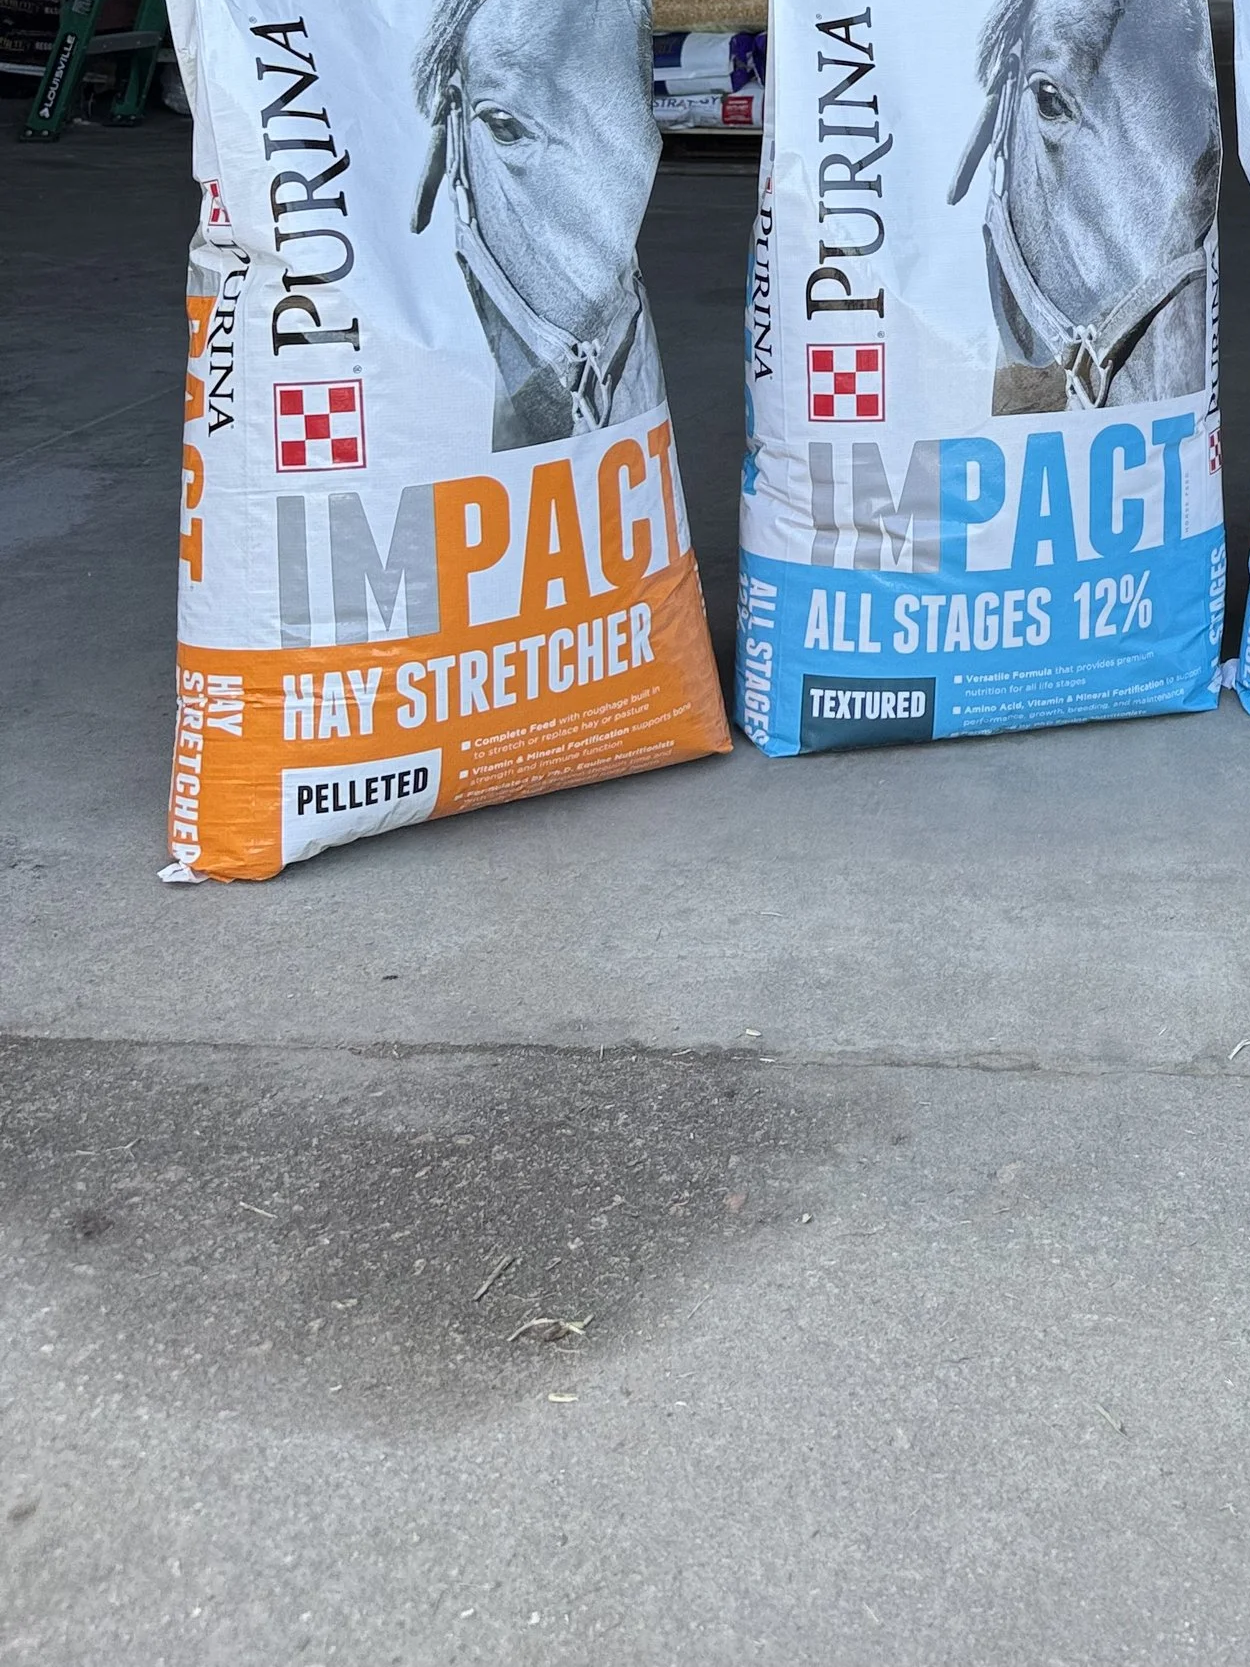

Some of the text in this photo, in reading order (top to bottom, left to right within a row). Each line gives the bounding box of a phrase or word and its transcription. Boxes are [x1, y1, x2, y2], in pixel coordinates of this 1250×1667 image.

[44, 34, 76, 108] LOUISVILLE
[250, 16, 361, 357] PURINA
[805, 6, 894, 321] PURINA
[208, 239, 251, 438] PURINA
[752, 206, 773, 382] PURINA
[276, 420, 689, 650] IMPACT
[808, 412, 1195, 574] IMPACT
[745, 578, 777, 745] ALL STAGES
[803, 569, 1153, 654] ALL STAGES 12%
[966, 651, 1154, 684] Versatile Formula that provides premium
[207, 674, 245, 738] HAY
[282, 601, 656, 742] HAY STRETCHER
[474, 685, 661, 748] Complete Feed with roughage built in
[809, 687, 926, 720] TEXTURED
[965, 677, 1087, 696] nutrition for all life stages
[297, 766, 429, 816] PELLETED
